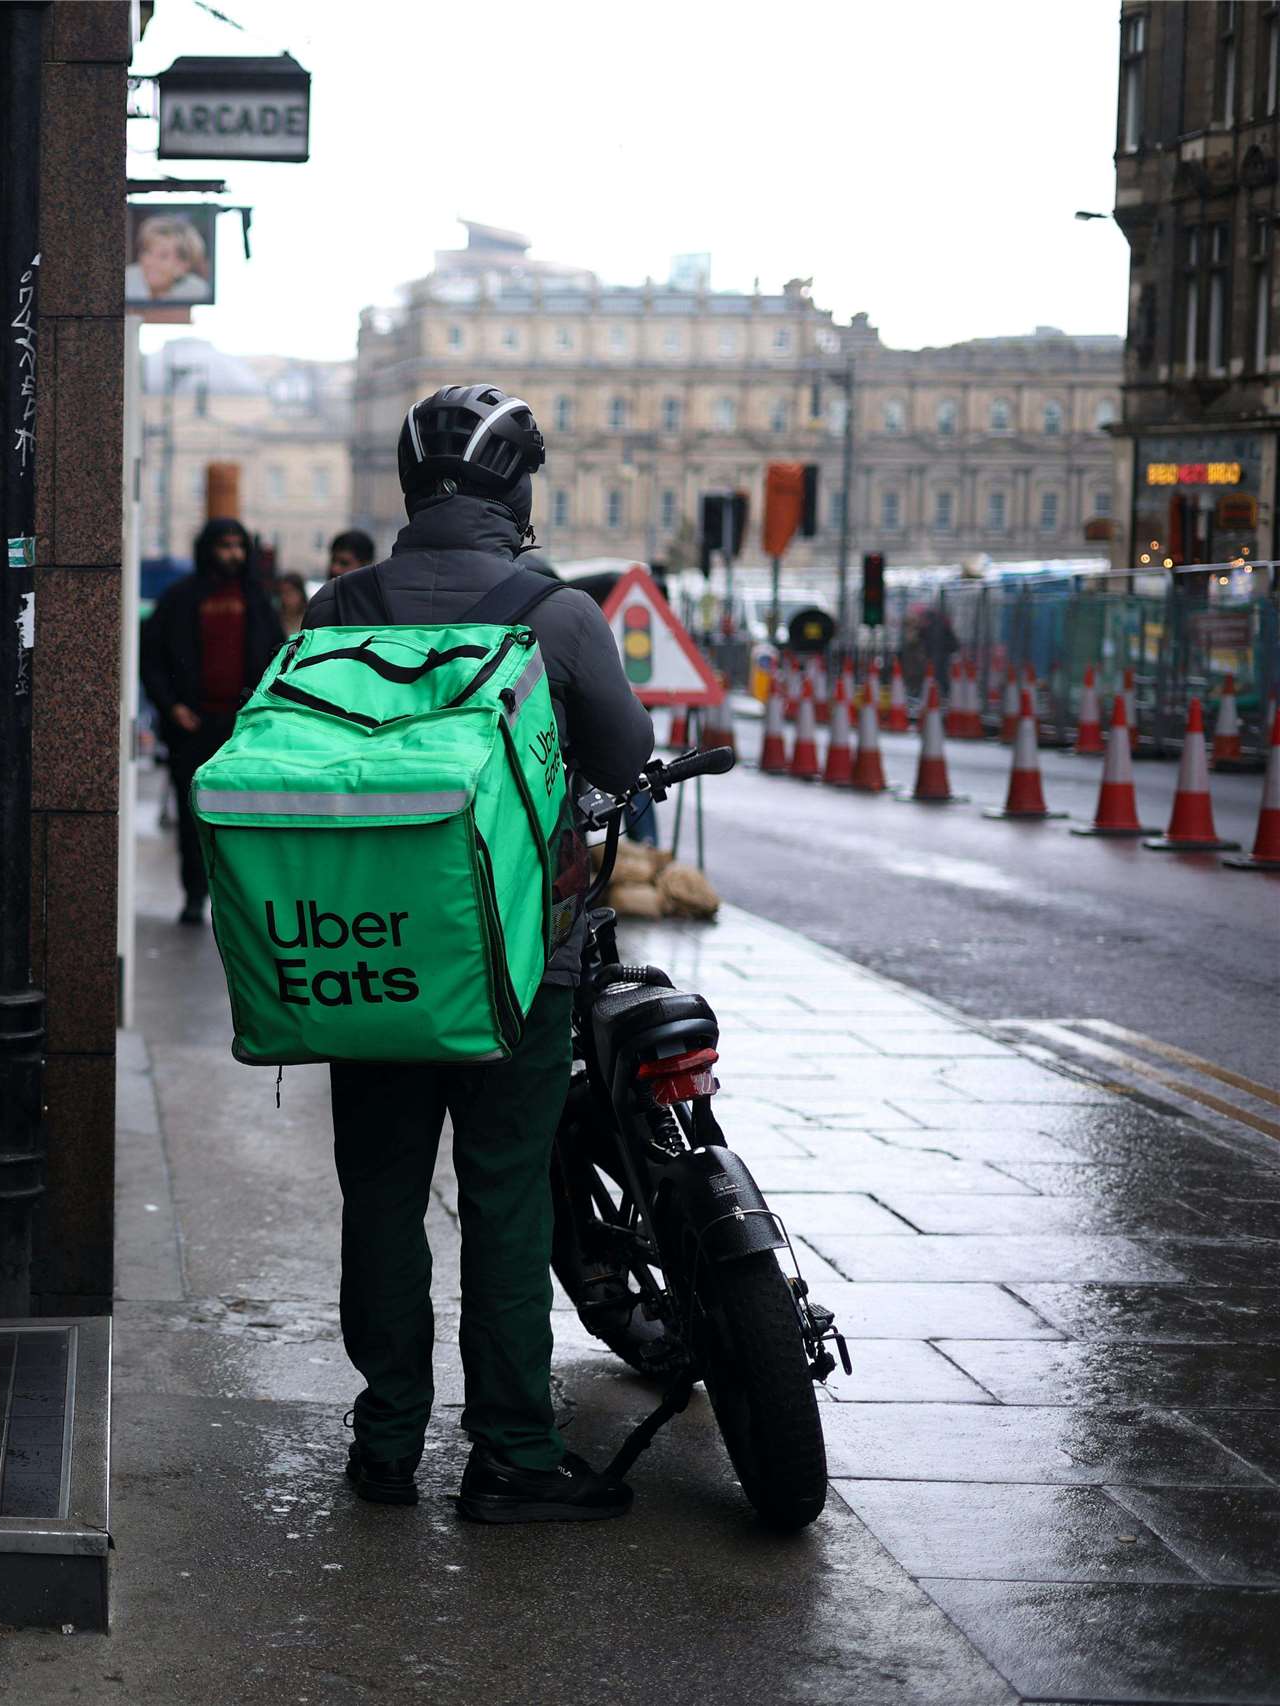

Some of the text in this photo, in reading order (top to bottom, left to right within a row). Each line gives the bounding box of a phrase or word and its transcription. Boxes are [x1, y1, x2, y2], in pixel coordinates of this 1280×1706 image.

[169, 103, 305, 136] ARCADE
[265, 900, 409, 949] Uber
[275, 958, 419, 1006] Eats
